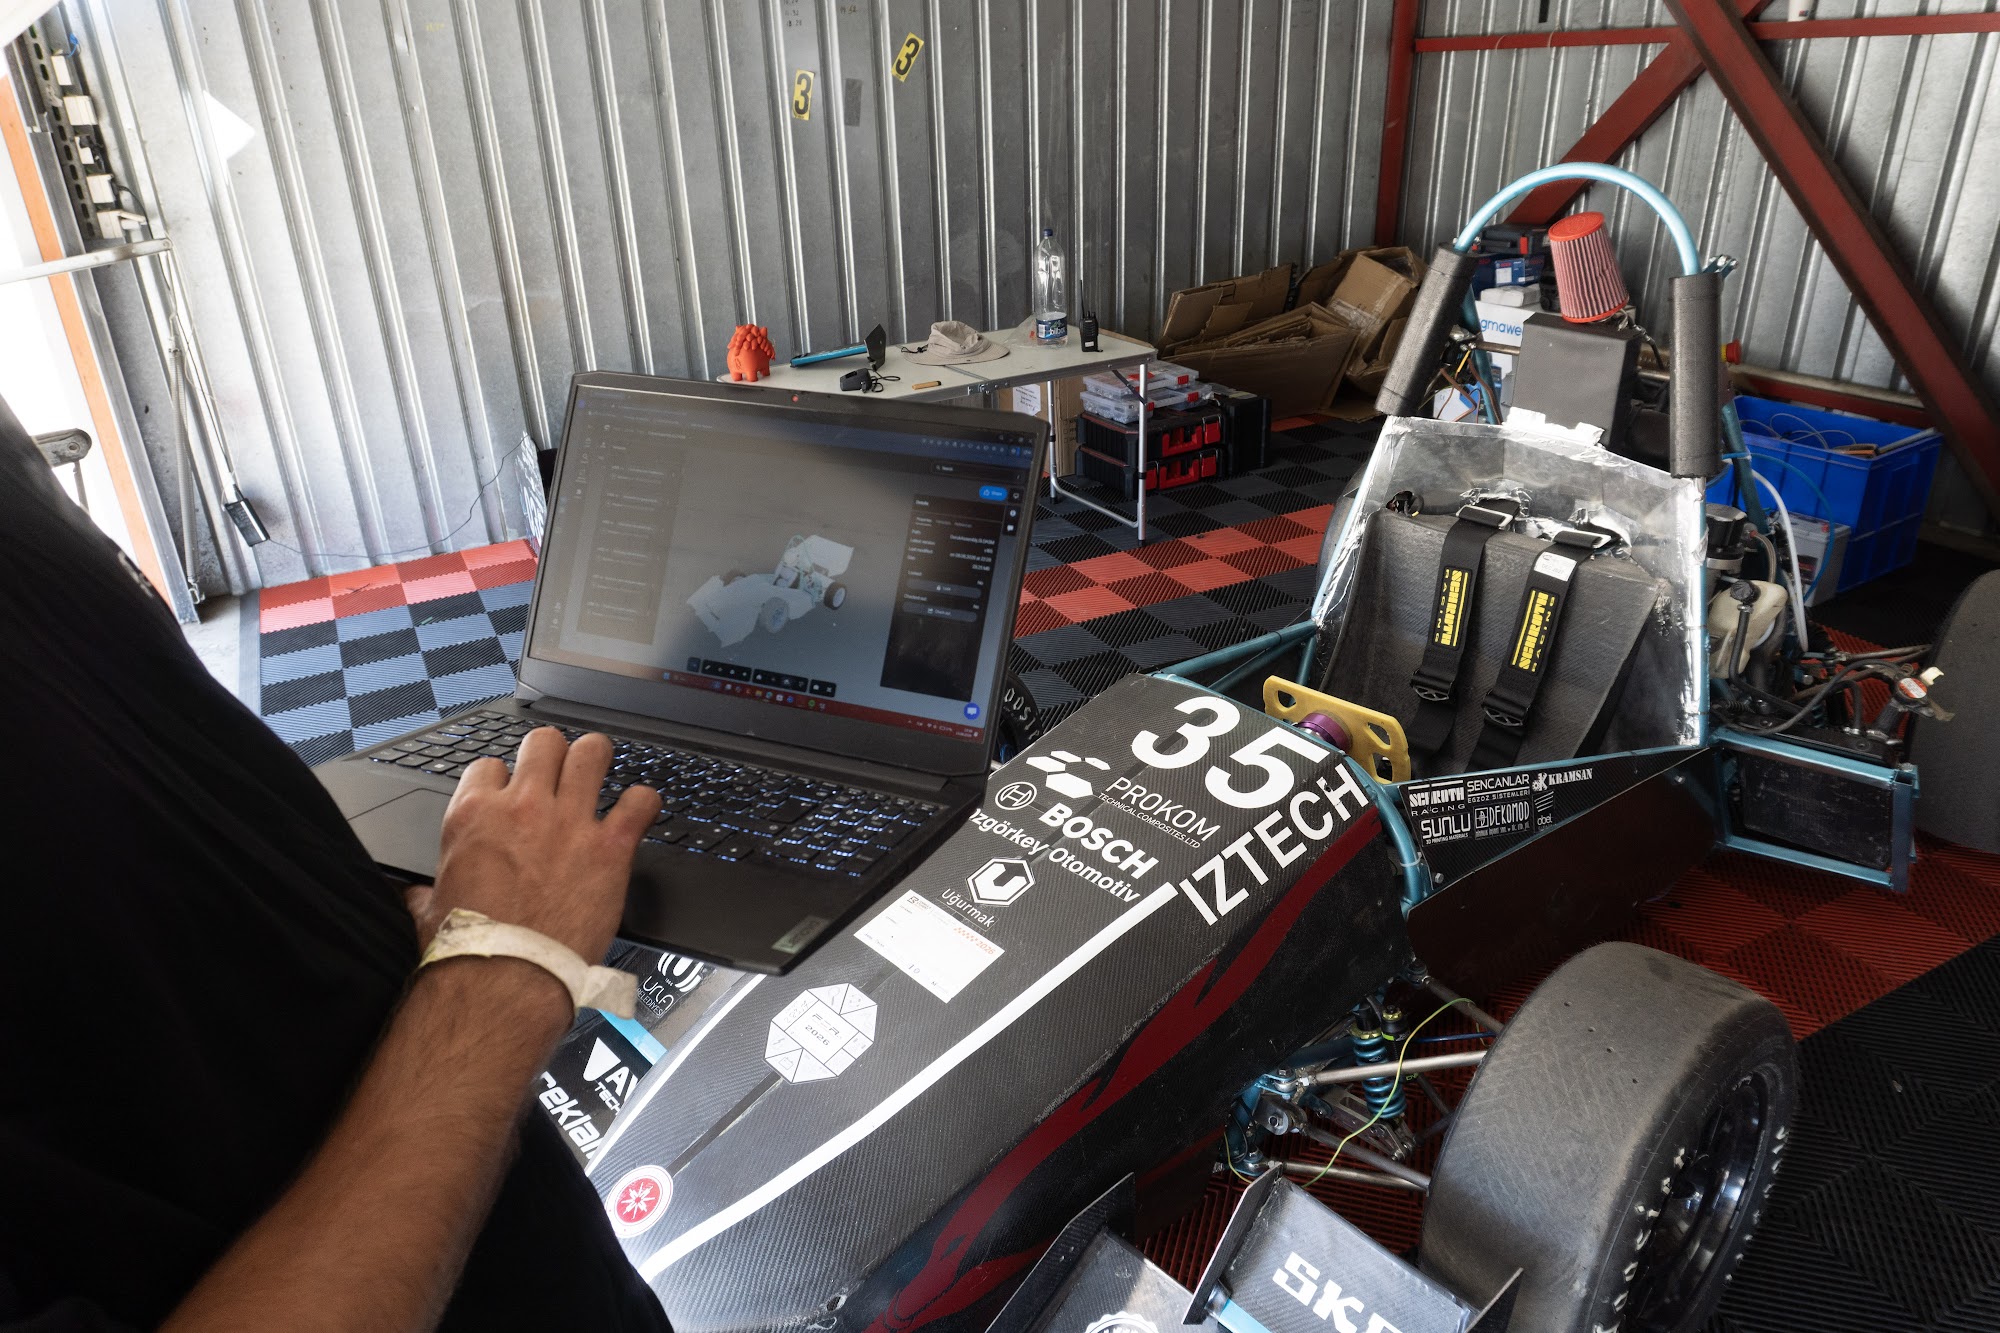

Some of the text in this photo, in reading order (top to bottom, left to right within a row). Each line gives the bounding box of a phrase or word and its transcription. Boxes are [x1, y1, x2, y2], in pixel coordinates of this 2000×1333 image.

[895, 37, 920, 76] 3
[794, 73, 812, 115] 3
[1131, 696, 1329, 809] 35
[1409, 786, 1465, 808] SCHROTH
[1548, 768, 1593, 786] KRAMSAN
[1098, 792, 1201, 849] TECHNICAL COMPOSITES LTD
[1105, 776, 1221, 843] PROKOM
[1411, 803, 1466, 817] RACING
[1489, 801, 1530, 827] DEKOMOD
[1039, 802, 1159, 880] BOSCH
[1179, 762, 1369, 927] IZTECH
[1048, 847, 1141, 903] Otomotiv
[941, 888, 996, 928] Uğurmak
[977, 939, 997, 956] 2026
[804, 1024, 831, 1047] 2026
